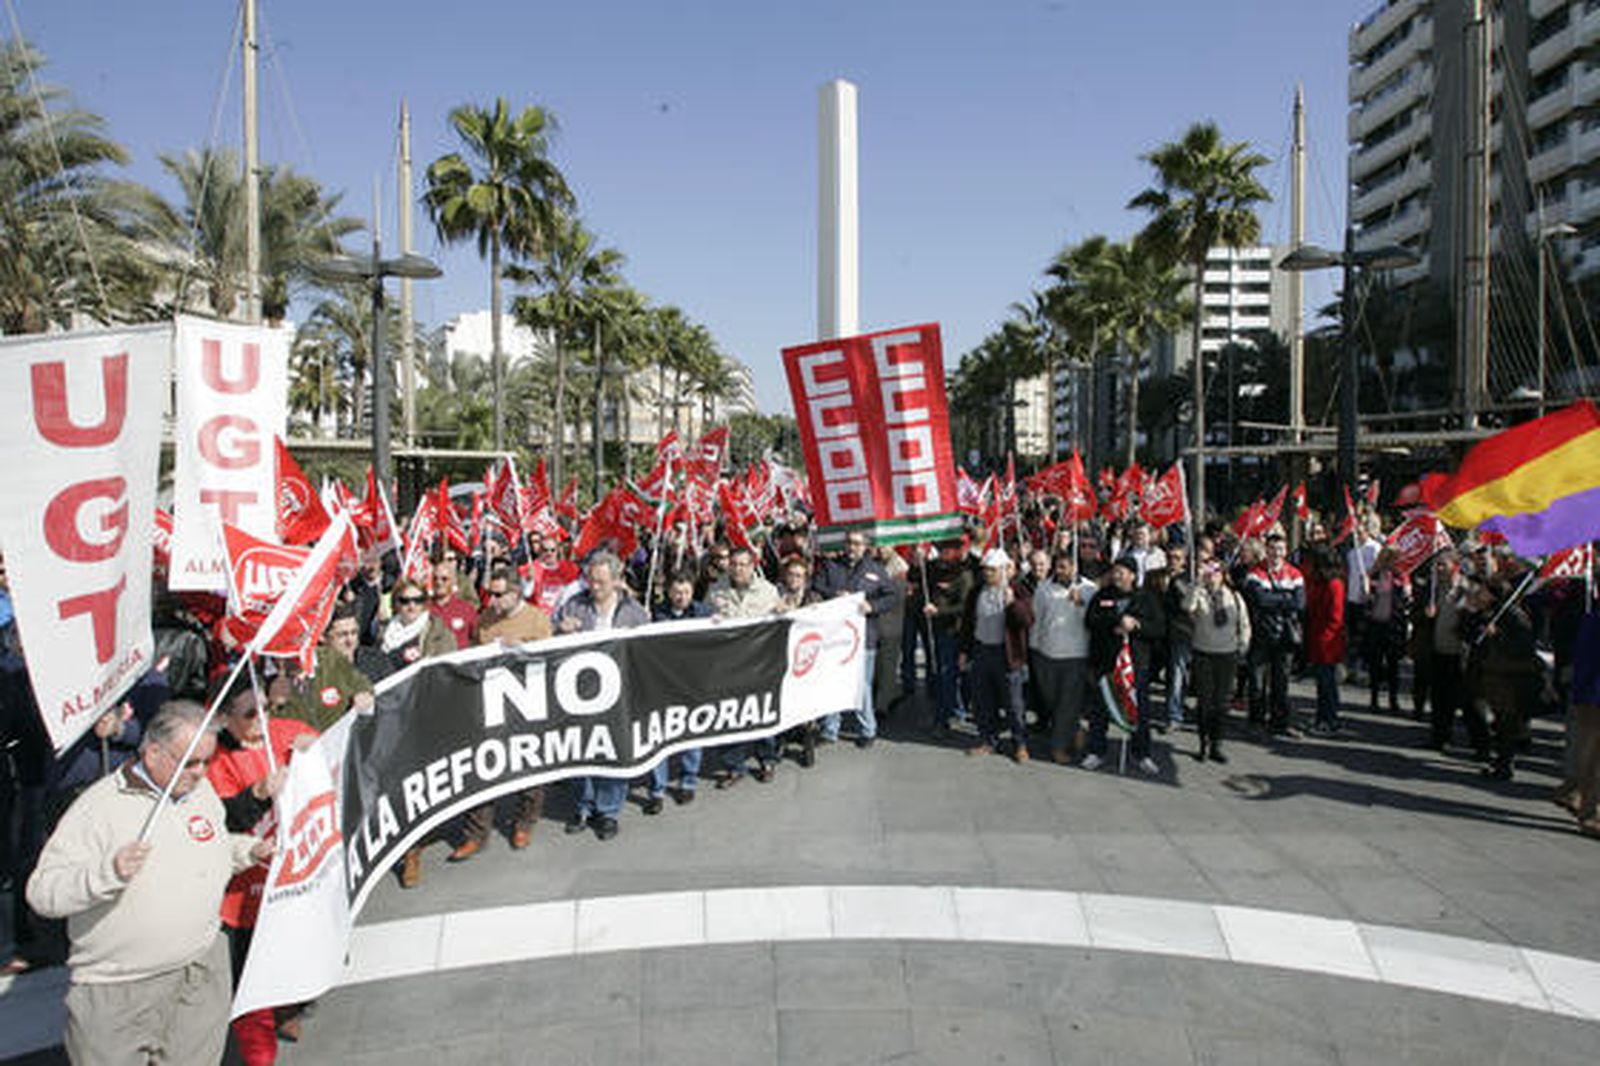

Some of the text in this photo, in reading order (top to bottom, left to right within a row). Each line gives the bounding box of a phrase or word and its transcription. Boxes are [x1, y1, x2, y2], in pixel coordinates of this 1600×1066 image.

[31, 352, 129, 665] UGT
[197, 338, 261, 524] UGT
[482, 651, 621, 727] NO
[348, 692, 777, 890] A LA REFORMA LABORAL
